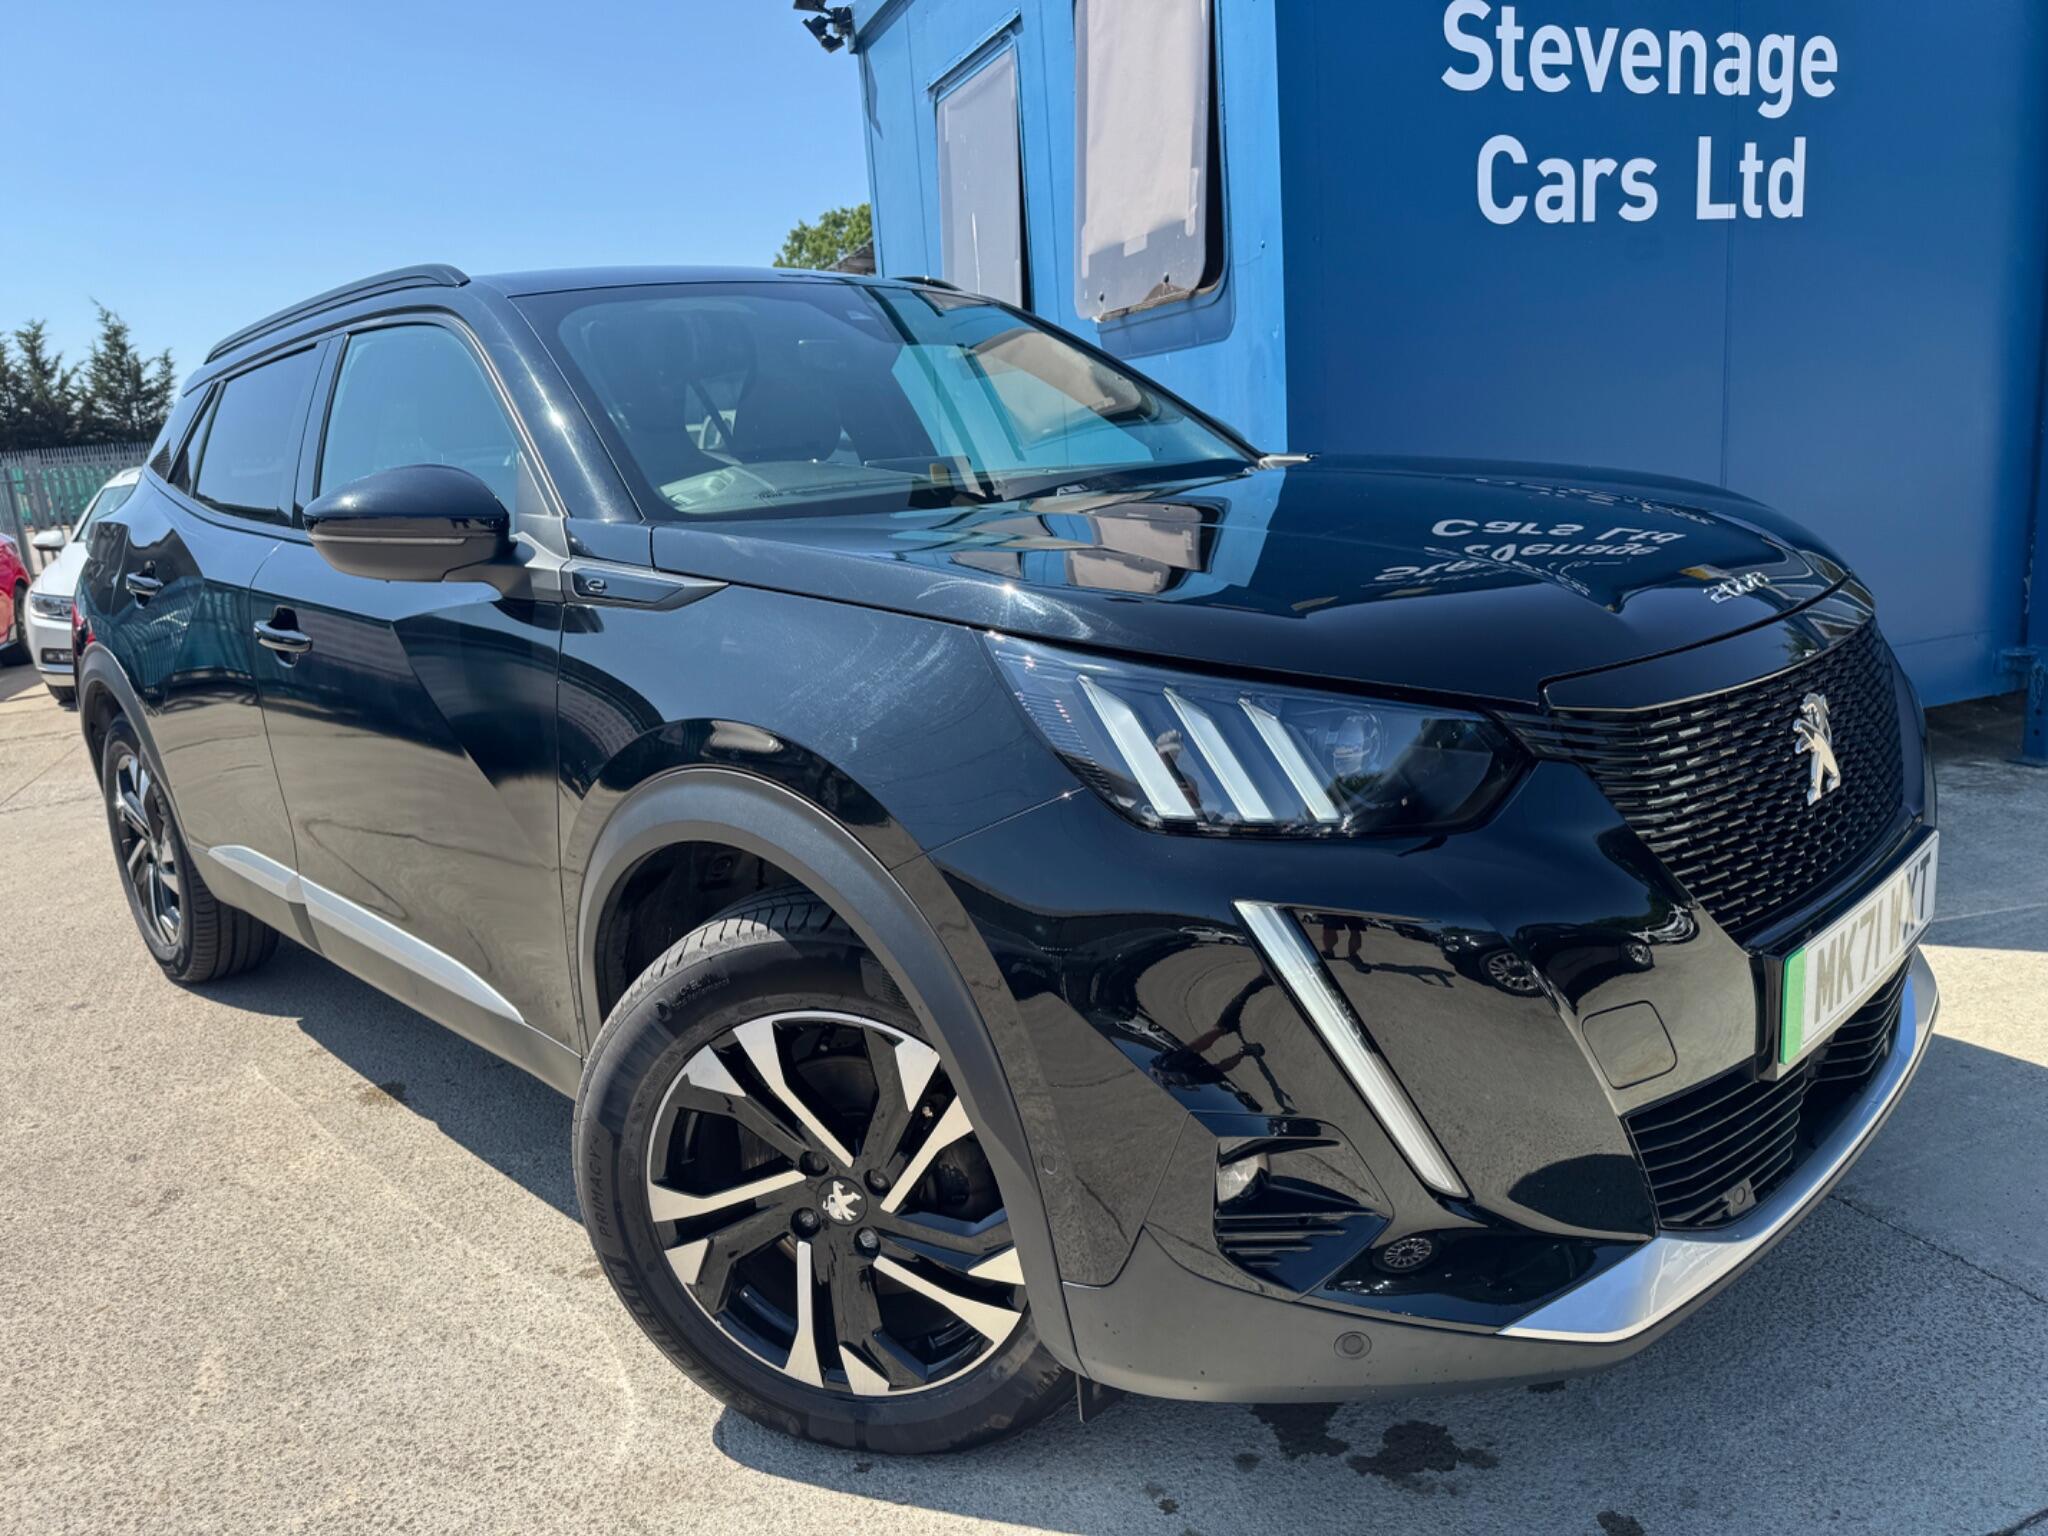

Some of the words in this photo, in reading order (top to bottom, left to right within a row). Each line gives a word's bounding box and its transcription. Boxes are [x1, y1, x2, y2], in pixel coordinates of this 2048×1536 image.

[1442, 0, 1838, 119] Stevenage
[1477, 135, 1658, 225] Cars
[1696, 136, 1806, 220] Ltd
[1814, 899, 1883, 1025] MK71
[589, 1146, 613, 1238] PRIMACY
